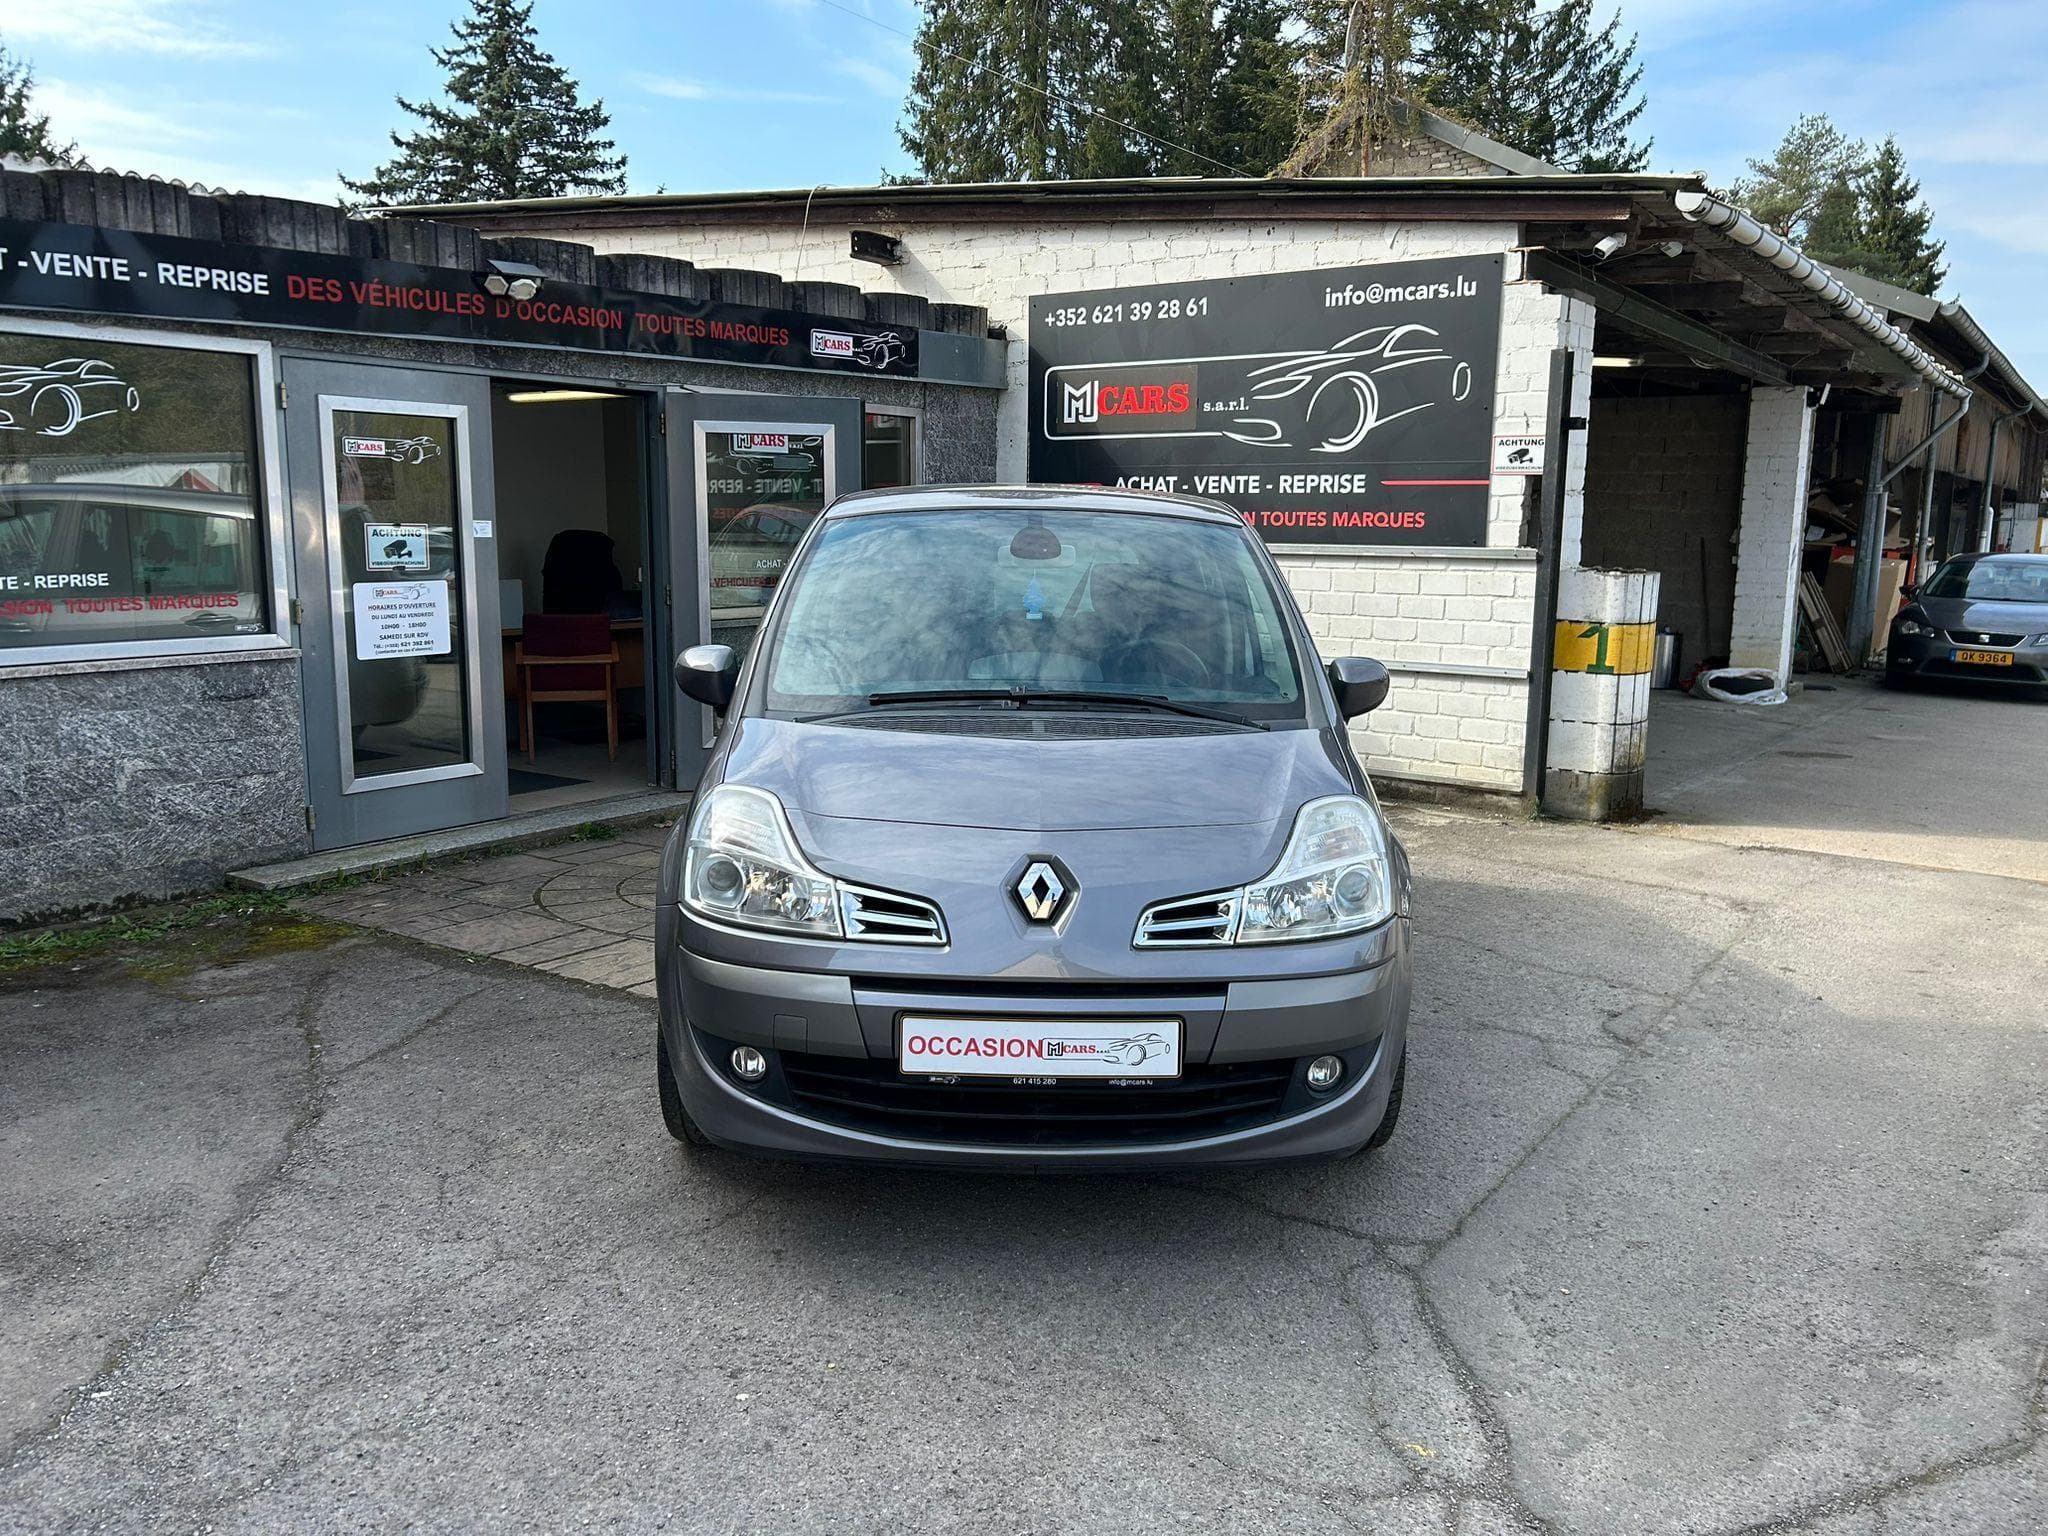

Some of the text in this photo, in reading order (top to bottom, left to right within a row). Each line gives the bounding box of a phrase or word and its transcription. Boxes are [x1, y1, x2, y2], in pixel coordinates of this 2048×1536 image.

[1325, 275, 1477, 308] info@mcars.lu
[157, 262, 270, 295] REPRISE
[287, 275, 343, 302] DES
[349, 278, 485, 315] VÉHICULES
[495, 298, 623, 330] D'OCCASION
[635, 312, 705, 338] TOUTES
[710, 320, 789, 346] MARQUES
[1044, 297, 1208, 327] +352 621 39 28 61
[1203, 397, 1250, 413] s.a.r.l.
[1115, 475, 1178, 493] ACHAT
[1193, 475, 1260, 494] VENTE
[1279, 474, 1366, 494] REPRISE
[1260, 511, 1327, 527] TOUTES
[1332, 511, 1425, 528] MARQUES
[372, 529, 422, 537] ACHTUNG
[756, 559, 782, 568] ACHAT
[34, 573, 109, 589] REPRISE
[65, 596, 144, 614] TOUTES
[149, 593, 239, 610] MARQUES
[399, 602, 436, 610] D'OUVERTURE
[1577, 625, 1615, 675] 1
[1978, 653, 2007, 663] 9364
[908, 1035, 1043, 1058] OCCASION
